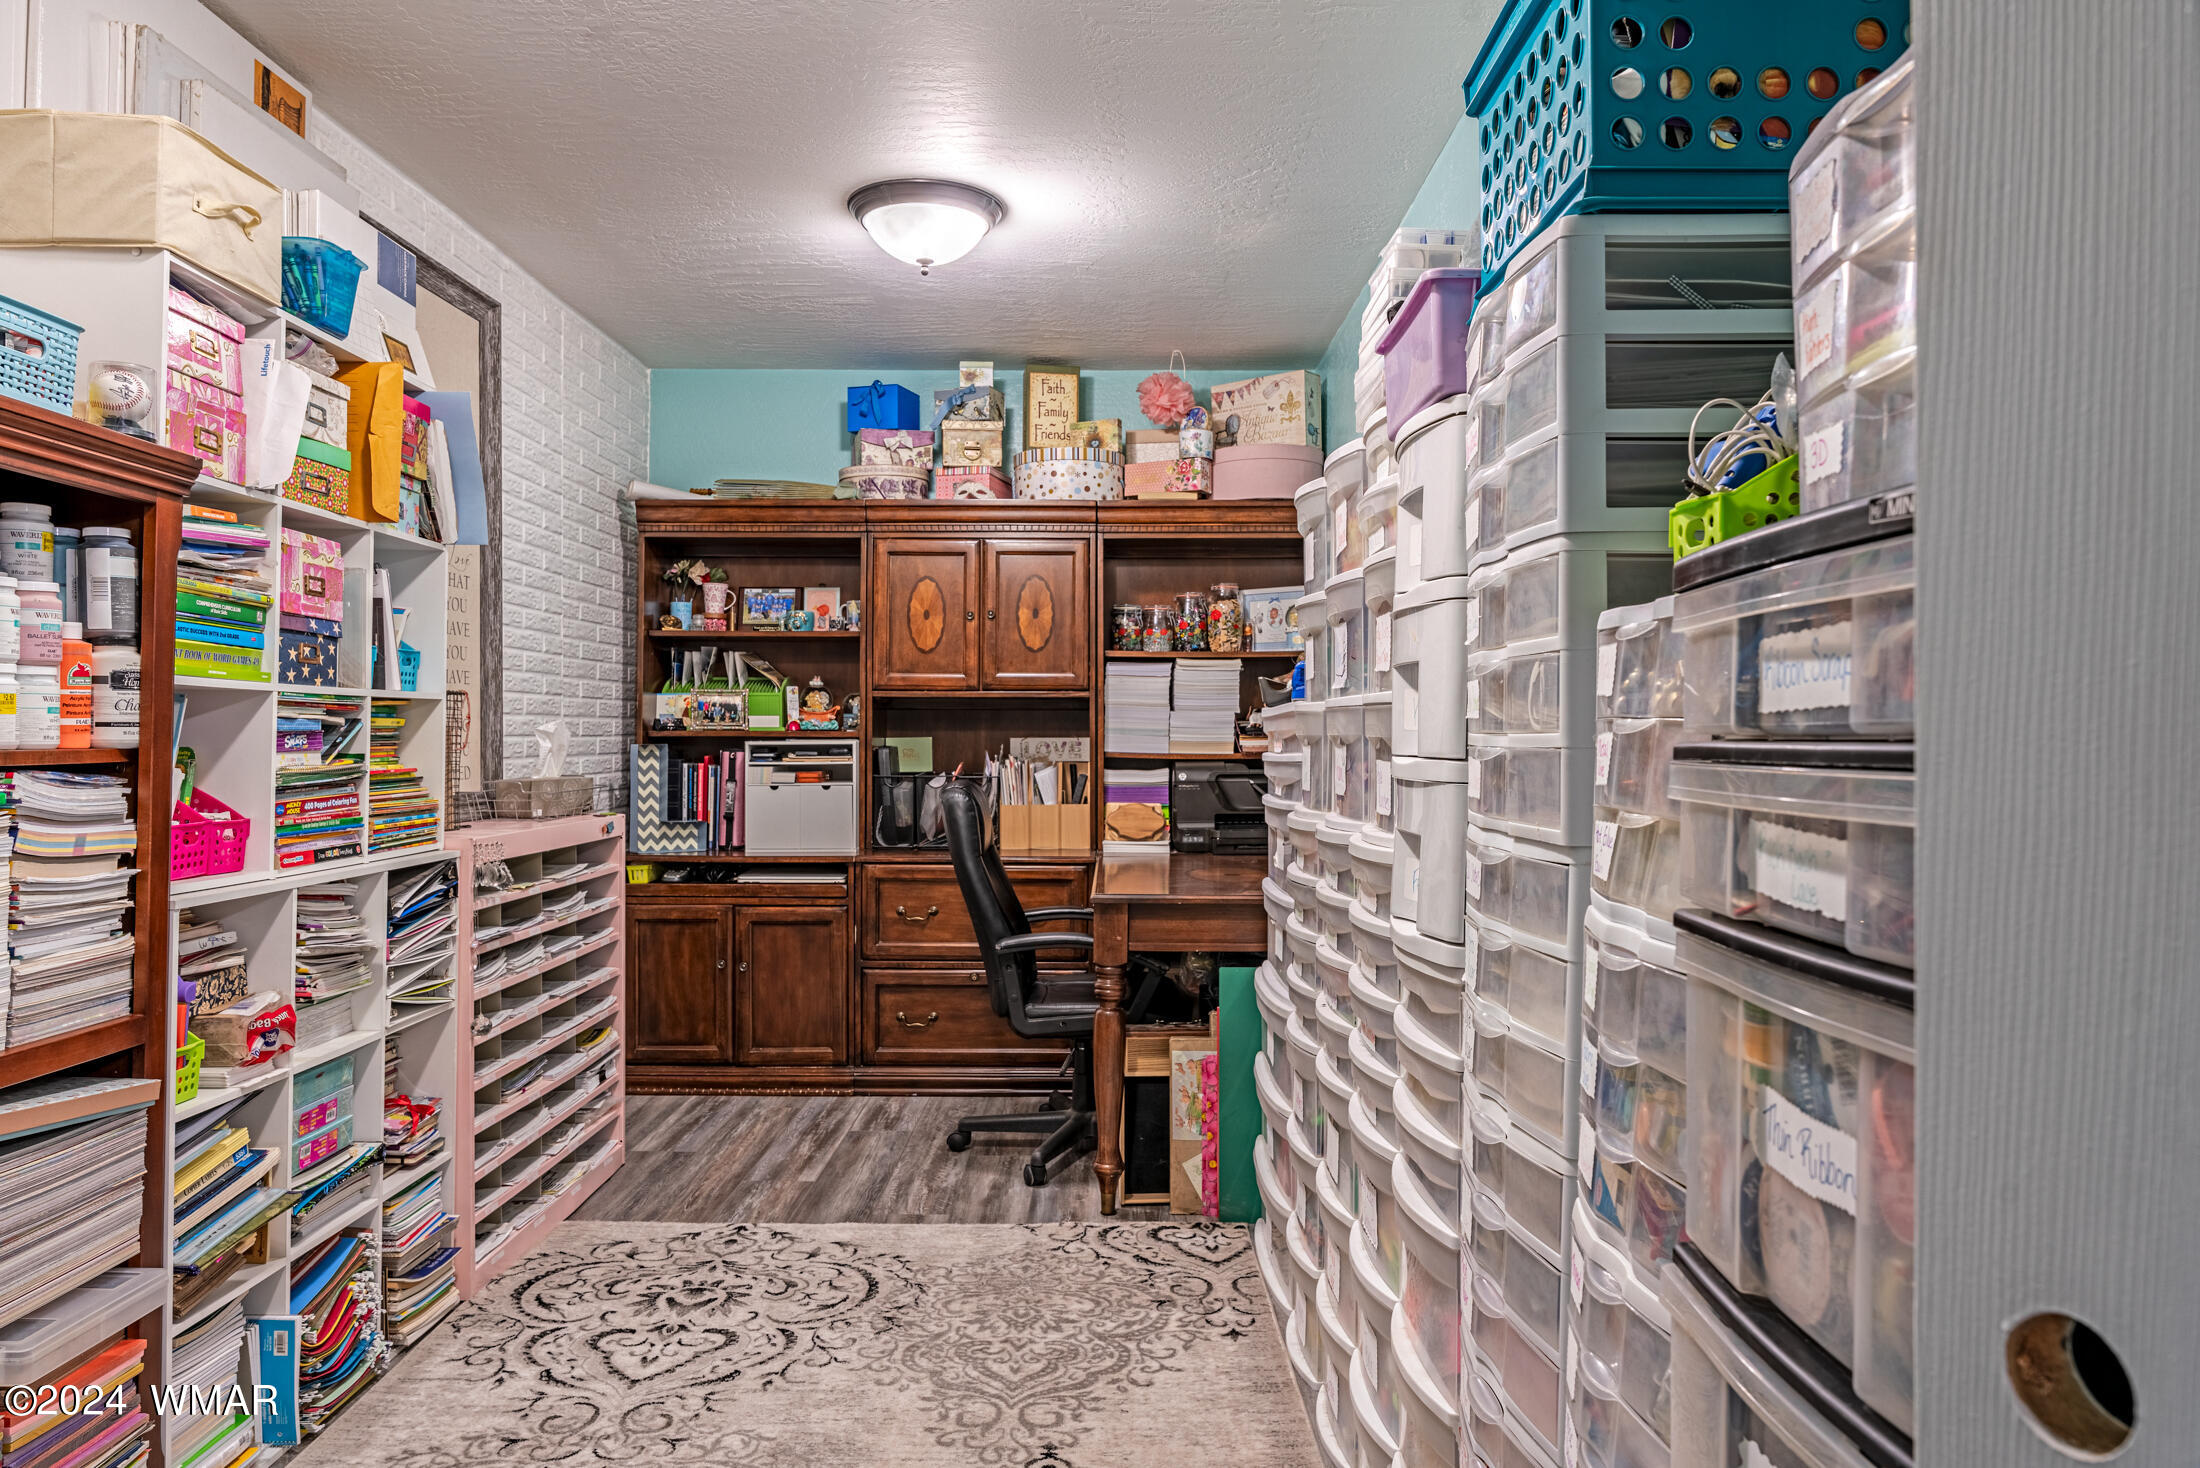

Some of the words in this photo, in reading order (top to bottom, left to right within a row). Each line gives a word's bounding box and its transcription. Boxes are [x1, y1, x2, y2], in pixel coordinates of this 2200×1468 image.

[260, 343, 271, 377] Lifetouch
[1041, 378, 1066, 396] Faith
[1038, 401, 1069, 424] Family
[1034, 424, 1071, 442] Friends
[1810, 438, 1829, 469] 3D
[10, 531, 43, 539] WAVERL
[448, 572, 470, 590] HAT
[190, 627, 208, 635] SUCCESS
[184, 649, 202, 660] BOOK
[213, 652, 231, 663] WORD
[232, 655, 251, 666] GAMES
[286, 801, 302, 809] MICKEY
[304, 801, 314, 810] 400
[314, 800, 327, 809] Pages
[332, 797, 350, 807] Coloring
[1762, 1103, 1795, 1159] Thin
[1796, 1127, 1857, 1200] Ribbon
